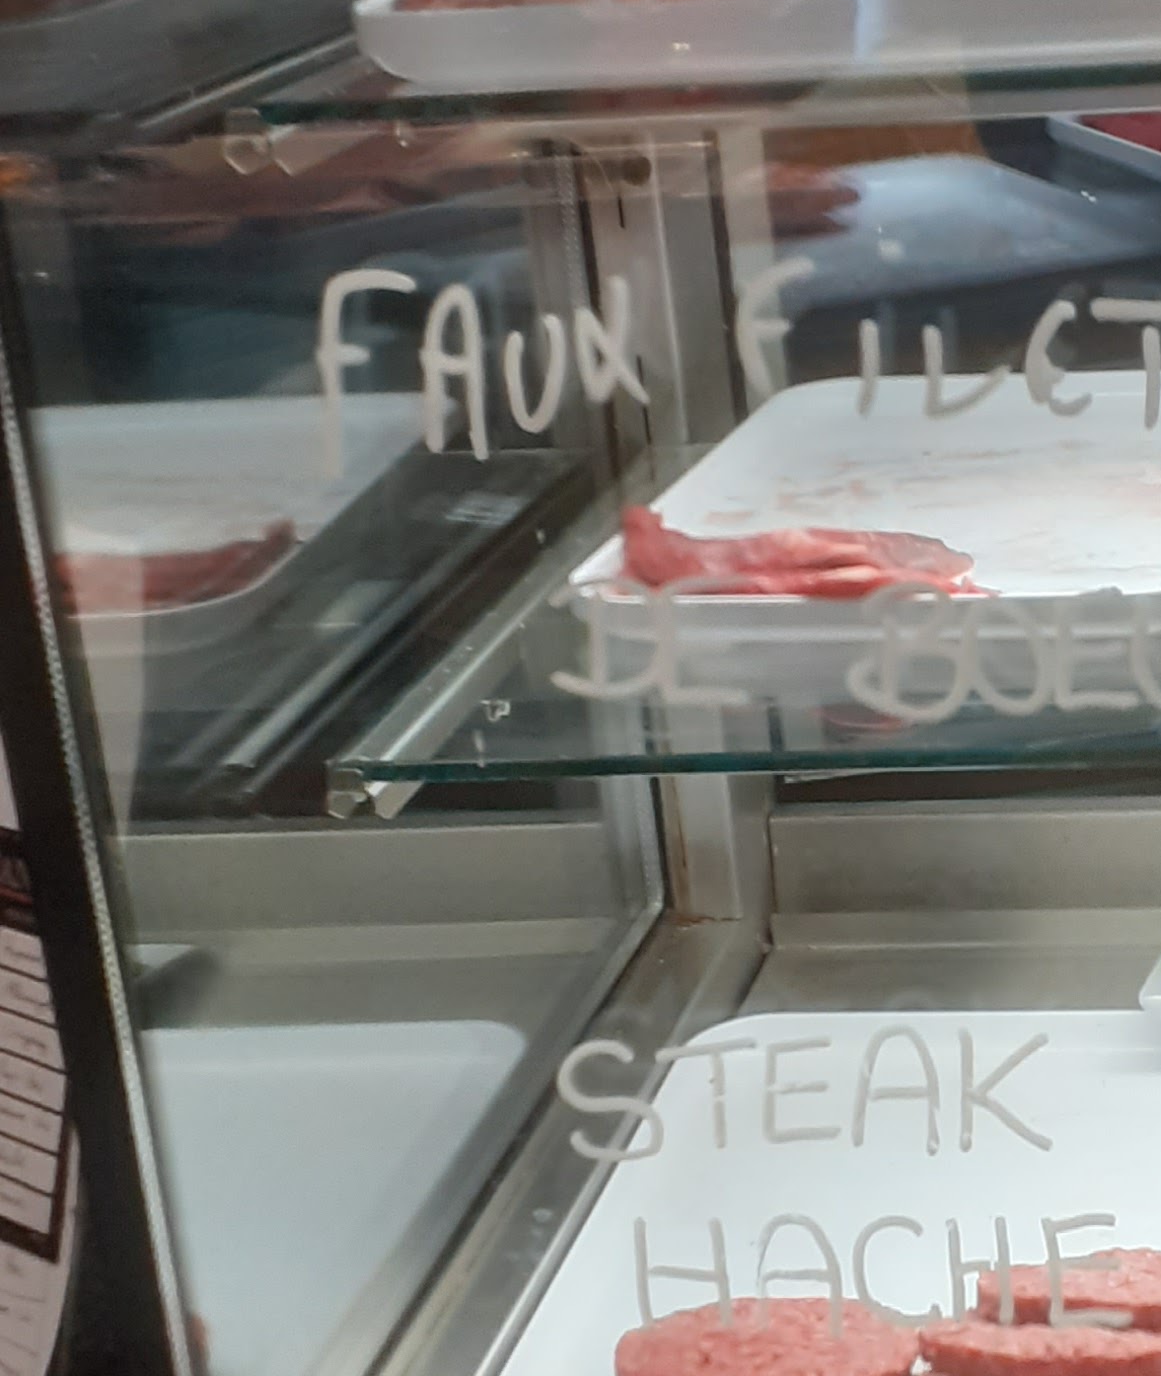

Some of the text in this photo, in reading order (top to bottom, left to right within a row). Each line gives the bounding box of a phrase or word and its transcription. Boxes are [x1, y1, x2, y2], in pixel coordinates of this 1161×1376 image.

[317, 267, 650, 480] FAUX
[550, 574, 750, 706] DE
[556, 1024, 1054, 1162] STEAK
[633, 1212, 1135, 1340] HACHE
